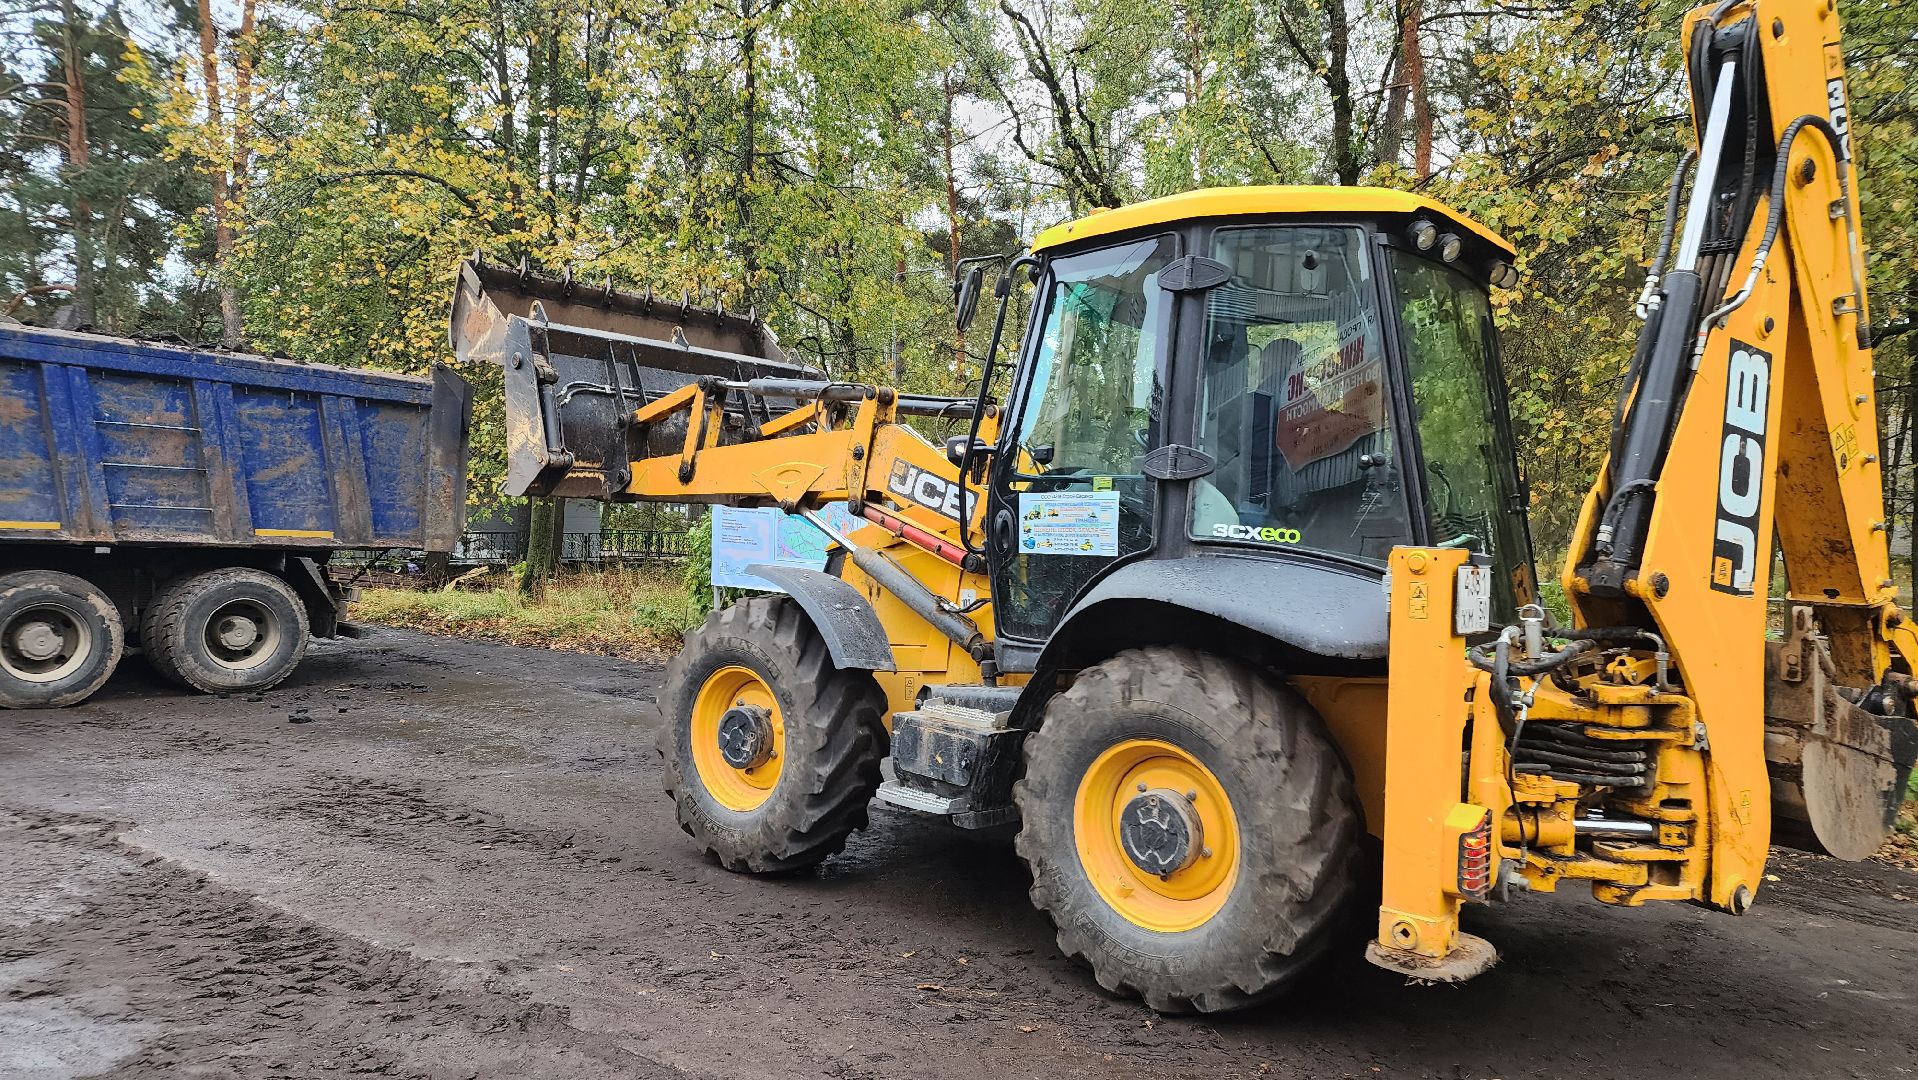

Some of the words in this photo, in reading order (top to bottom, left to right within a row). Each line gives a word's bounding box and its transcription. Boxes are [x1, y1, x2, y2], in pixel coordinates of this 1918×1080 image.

[890, 466, 976, 522] JCB
[1717, 350, 1768, 588] JCB
[1213, 524, 1301, 543] 3CXeco
